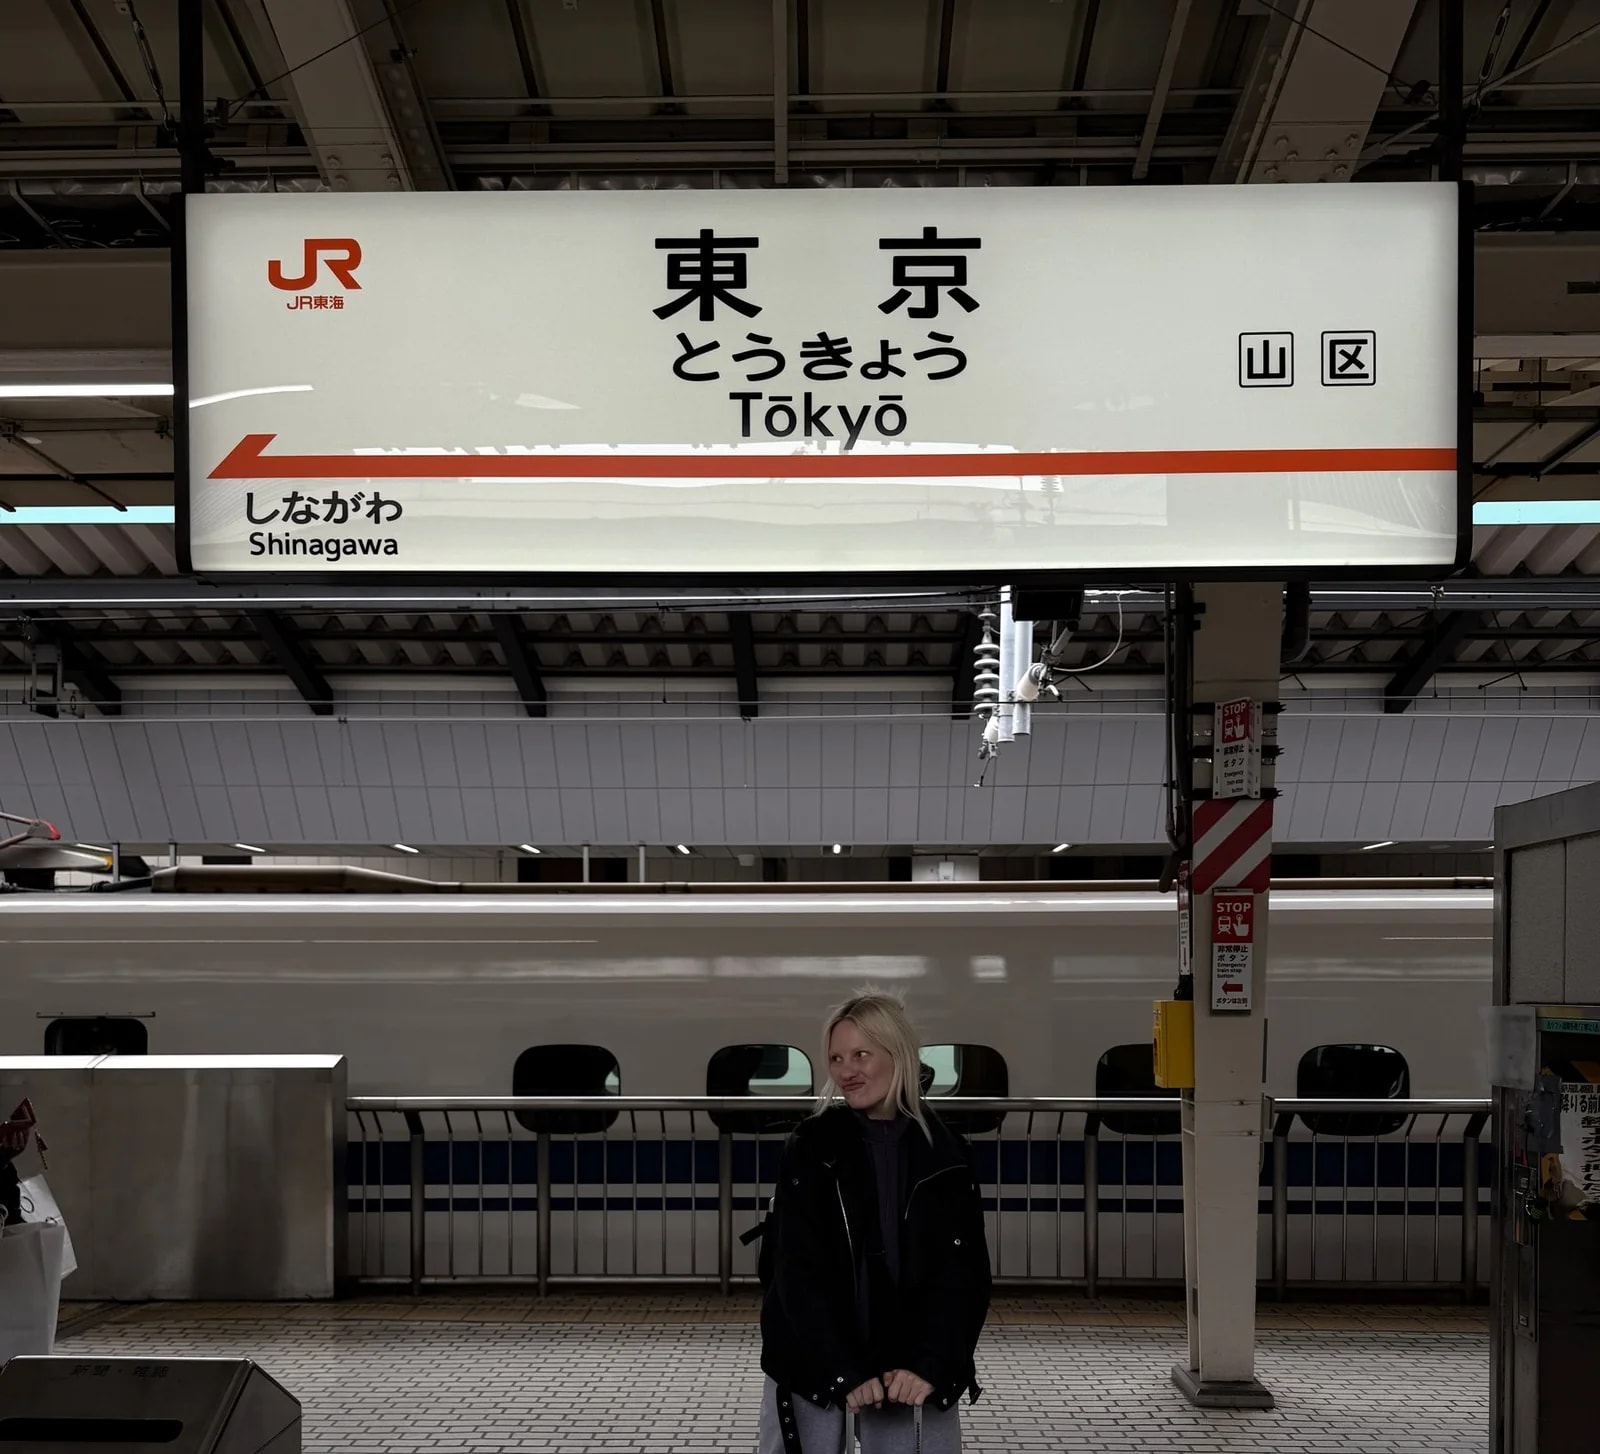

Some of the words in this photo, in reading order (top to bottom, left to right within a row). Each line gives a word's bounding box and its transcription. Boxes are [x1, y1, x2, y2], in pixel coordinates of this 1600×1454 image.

[268, 238, 362, 290] JR
[652, 226, 982, 322] 東京
[287, 295, 345, 310] JR東海
[672, 331, 968, 382] とうきょう
[1246, 338, 1287, 381] 山
[1328, 338, 1371, 380] 区
[729, 391, 908, 451] Tōkyō
[246, 490, 403, 525] しながわ
[249, 532, 399, 562] Shinagawa
[1223, 702, 1246, 717] STOP
[1216, 902, 1251, 913] STOP
[1217, 945, 1249, 953] 非常停止
[1217, 954, 1248, 962] ボタン
[1560, 1094, 1600, 1113] 降りる前
